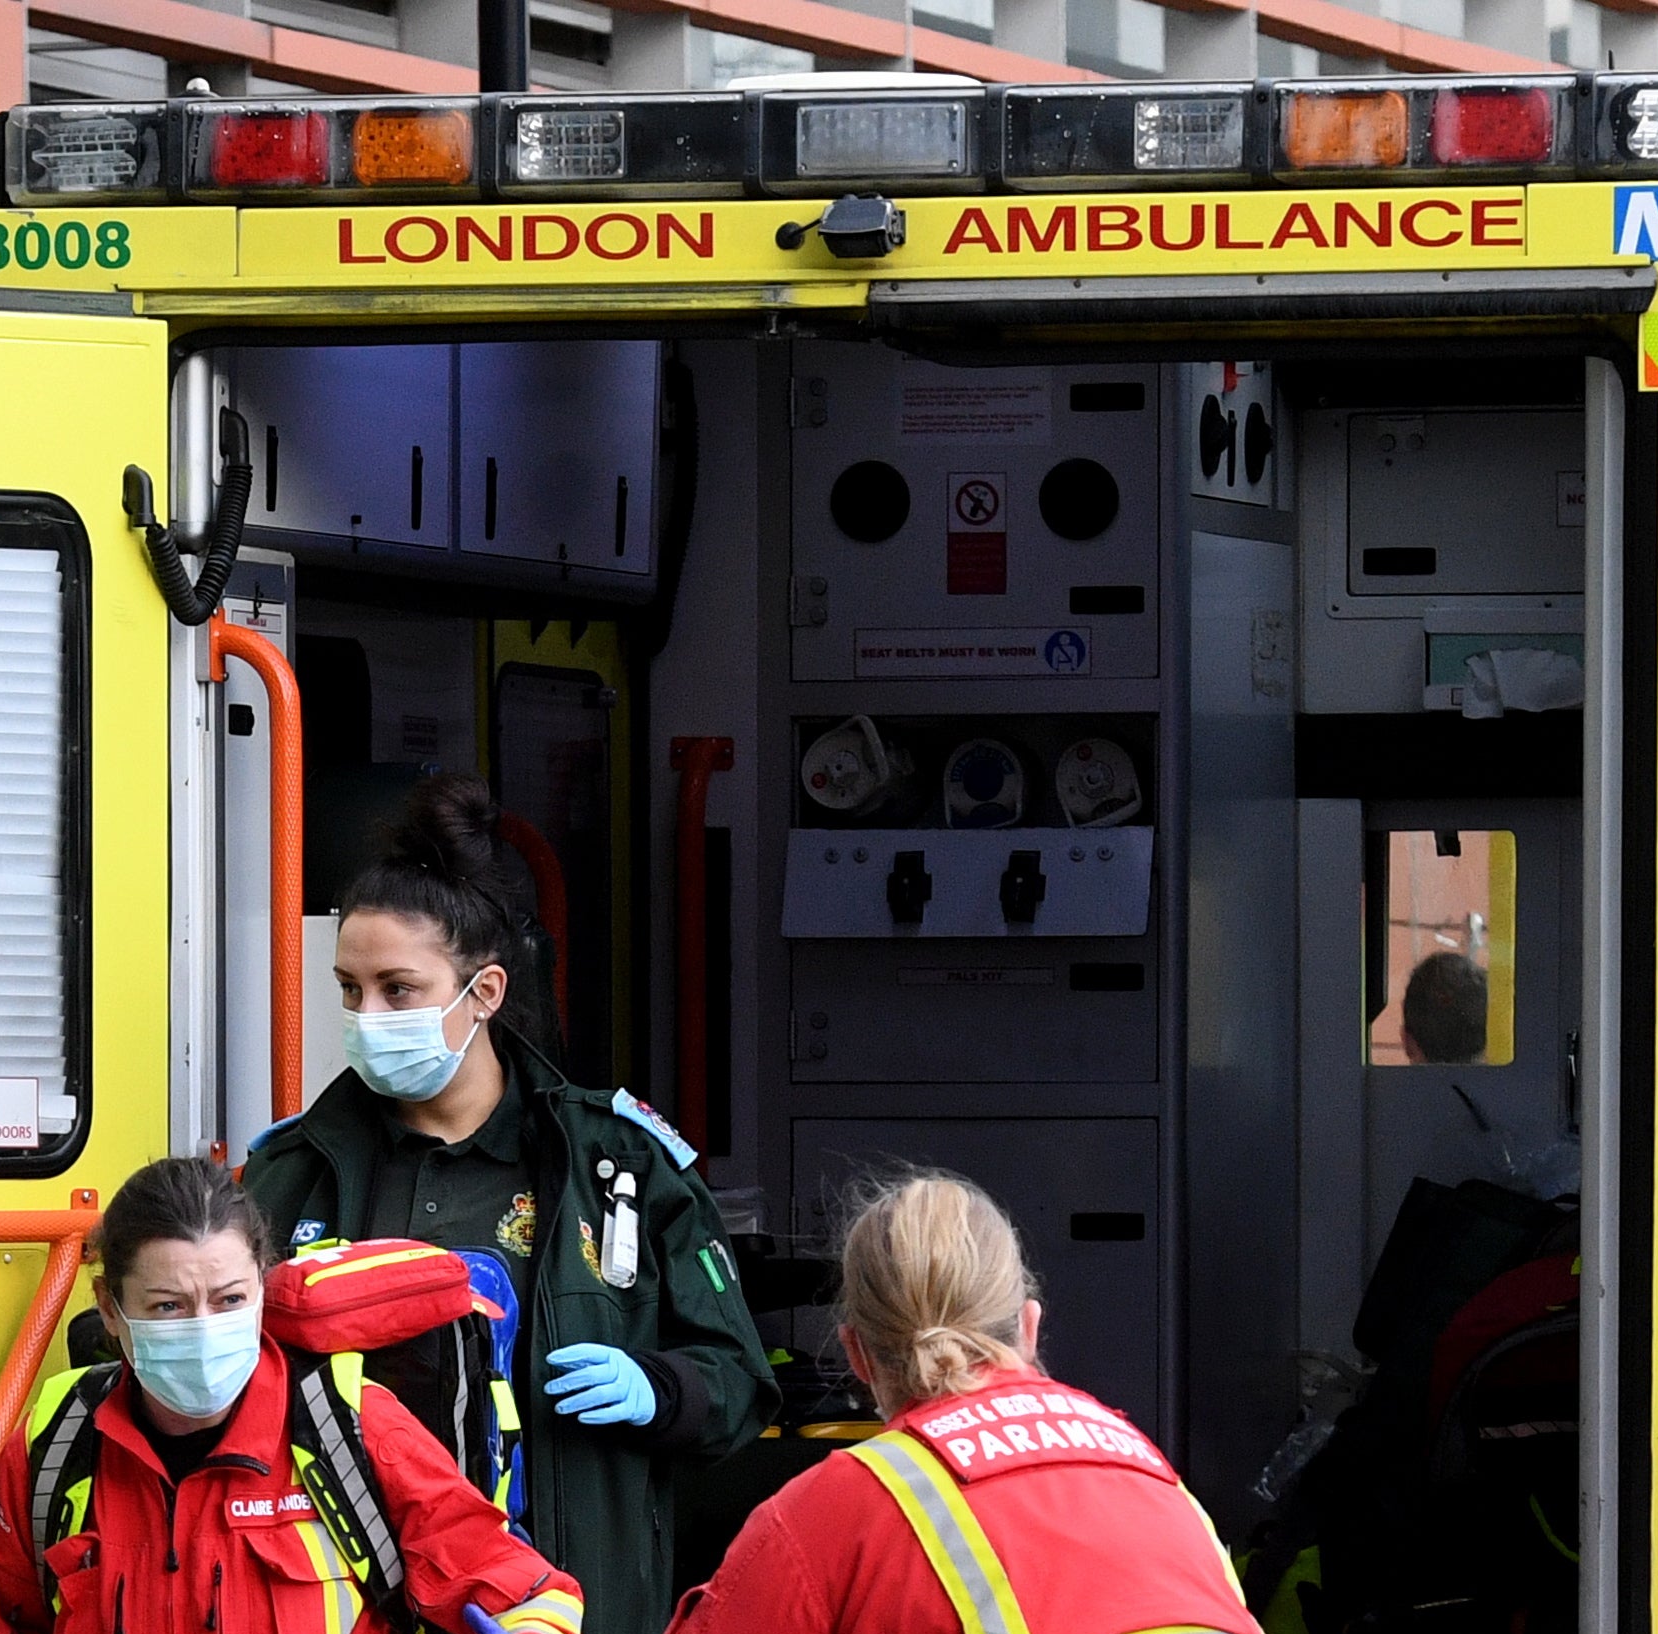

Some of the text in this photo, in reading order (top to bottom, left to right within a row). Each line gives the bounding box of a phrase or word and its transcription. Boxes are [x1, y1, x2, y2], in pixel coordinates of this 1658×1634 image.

[338, 197, 1525, 264] LONDON AMBULANCE
[861, 648, 892, 659] SEAT
[896, 647, 935, 658] BELTS
[938, 647, 974, 658] MUST
[998, 646, 1036, 657] WORN
[293, 1222, 322, 1241] HS
[921, 1407, 981, 1438] ESSEX
[946, 1420, 1163, 1467] PARAMEDIC
[231, 1494, 312, 1517] CLAIRE ANDE
